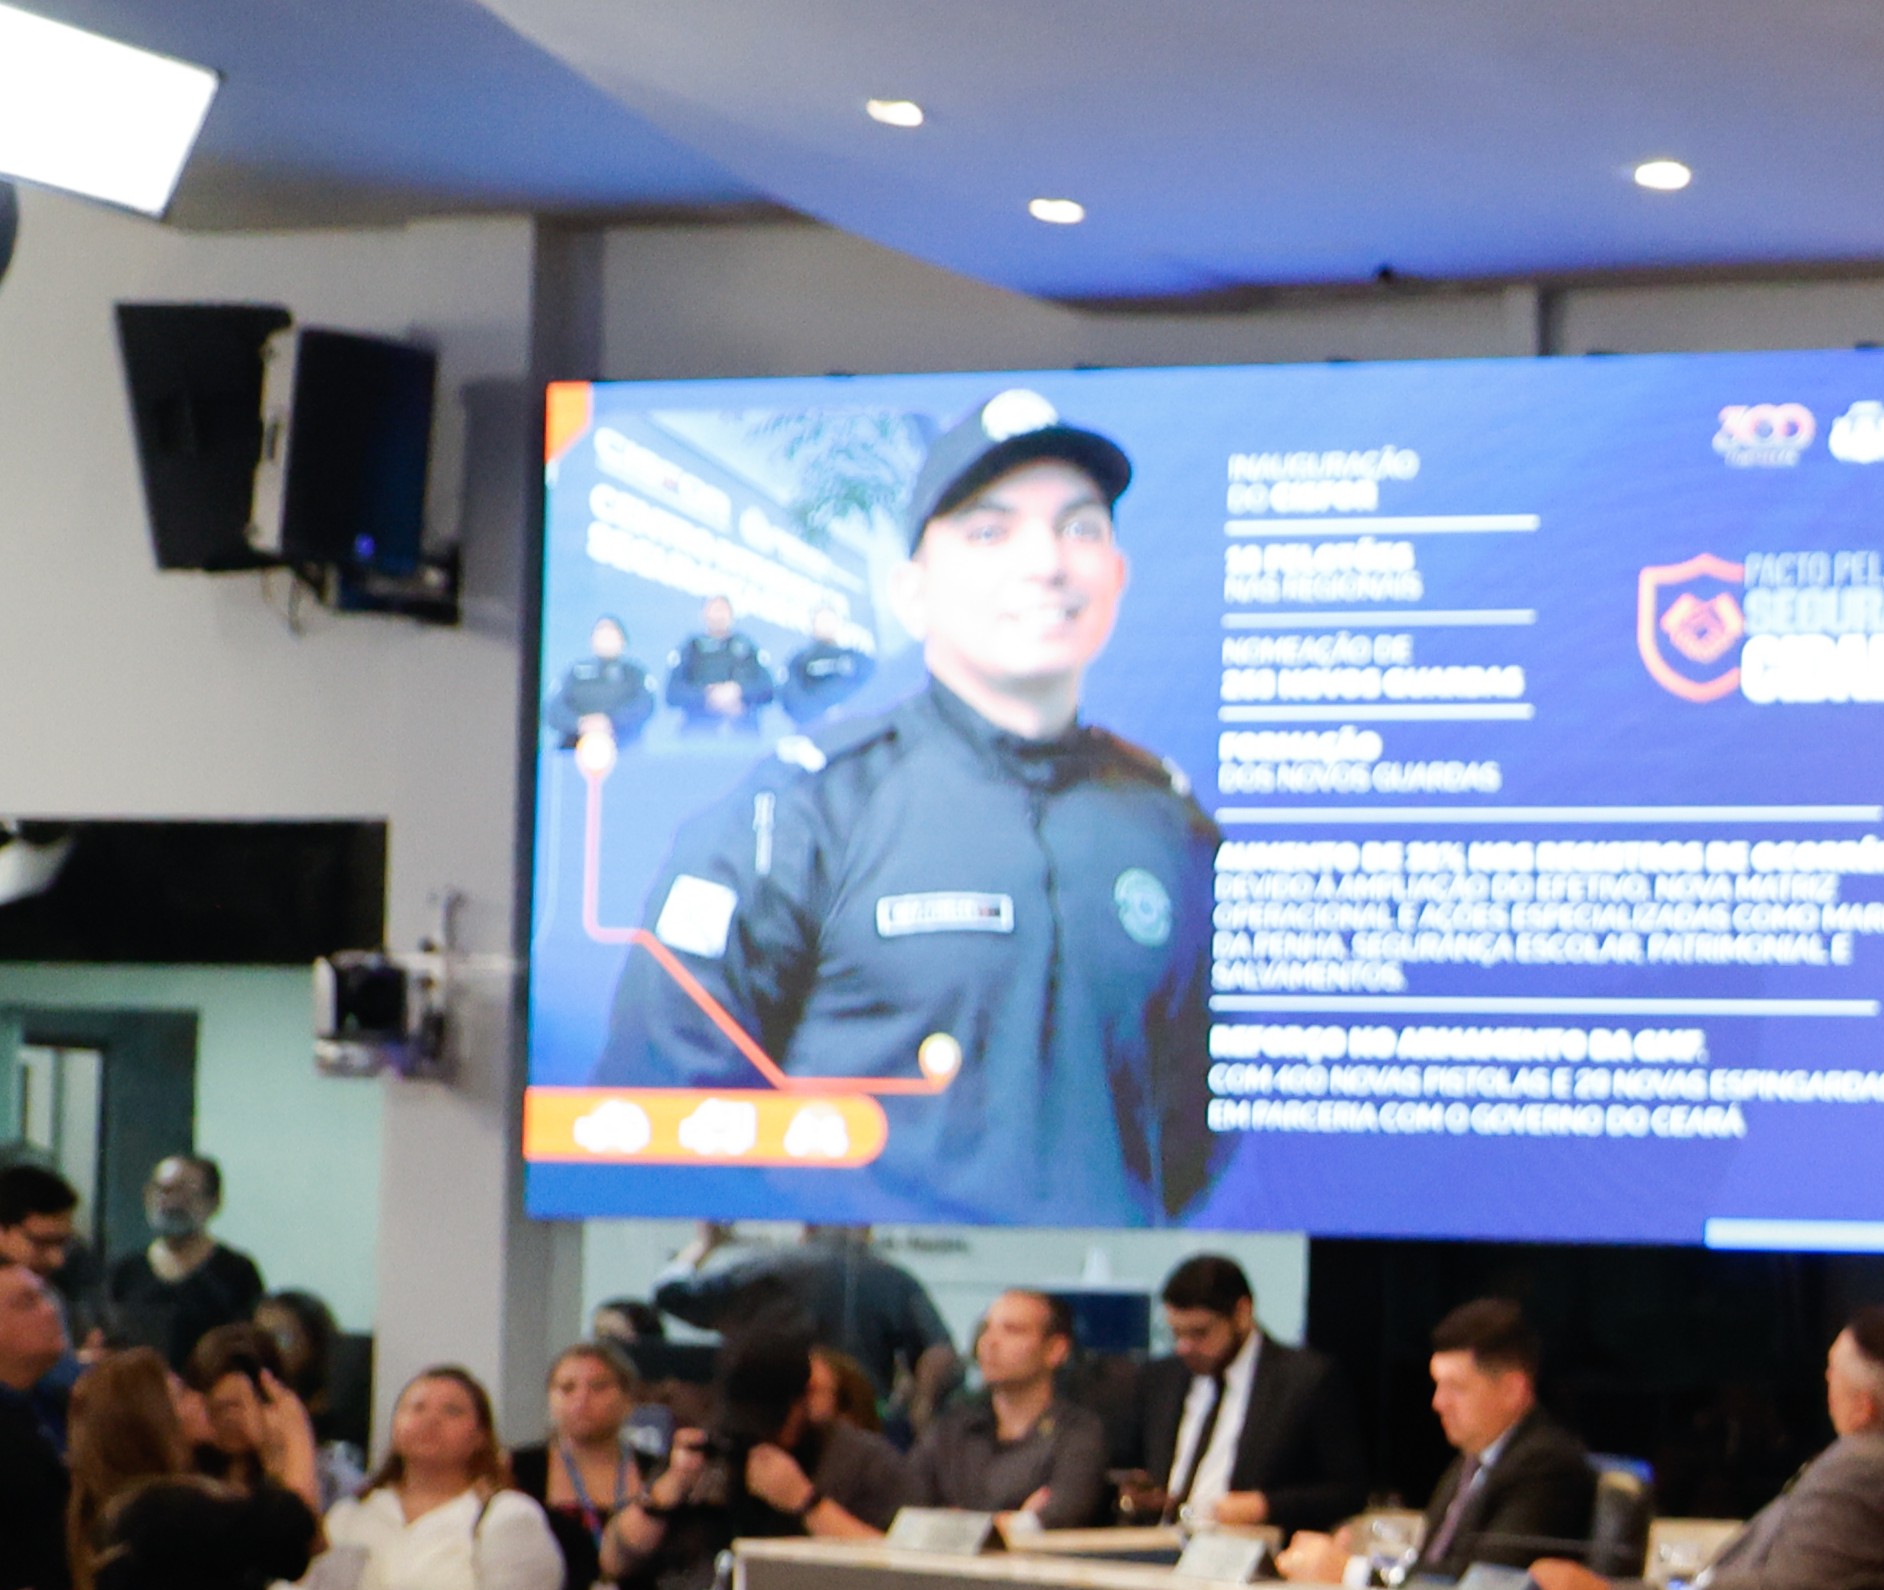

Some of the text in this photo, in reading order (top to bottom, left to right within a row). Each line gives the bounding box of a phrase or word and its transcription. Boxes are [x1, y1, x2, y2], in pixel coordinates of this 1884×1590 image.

[1227, 483, 1269, 514] DO
[1744, 552, 1829, 587] PACTO
[1374, 634, 1412, 665] DE
[1219, 761, 1501, 793] DOS NOVOS GUARDAS
[1655, 874, 1732, 902] NOVA
[1735, 874, 1838, 903] MATRIZ
[1398, 903, 1416, 930] E
[1733, 903, 1819, 931] COMO
[1213, 931, 1251, 960] DA
[1352, 932, 1513, 964] SEGURANÇA
[1831, 933, 1852, 964] E
[1209, 1064, 1272, 1095] COM
[1330, 1066, 1421, 1096] NOVAS
[1423, 1066, 1550, 1098] PISTOLAS
[1552, 1068, 1571, 1098] E
[1613, 1069, 1706, 1100] NOVAS
[1208, 1100, 1250, 1130] EM
[1252, 1100, 1378, 1131] PARCERIA
[1379, 1102, 1444, 1132] COM
[1445, 1103, 1469, 1132] O
[1471, 1103, 1603, 1134] GOVERNO
[1606, 1104, 1648, 1135] DO
